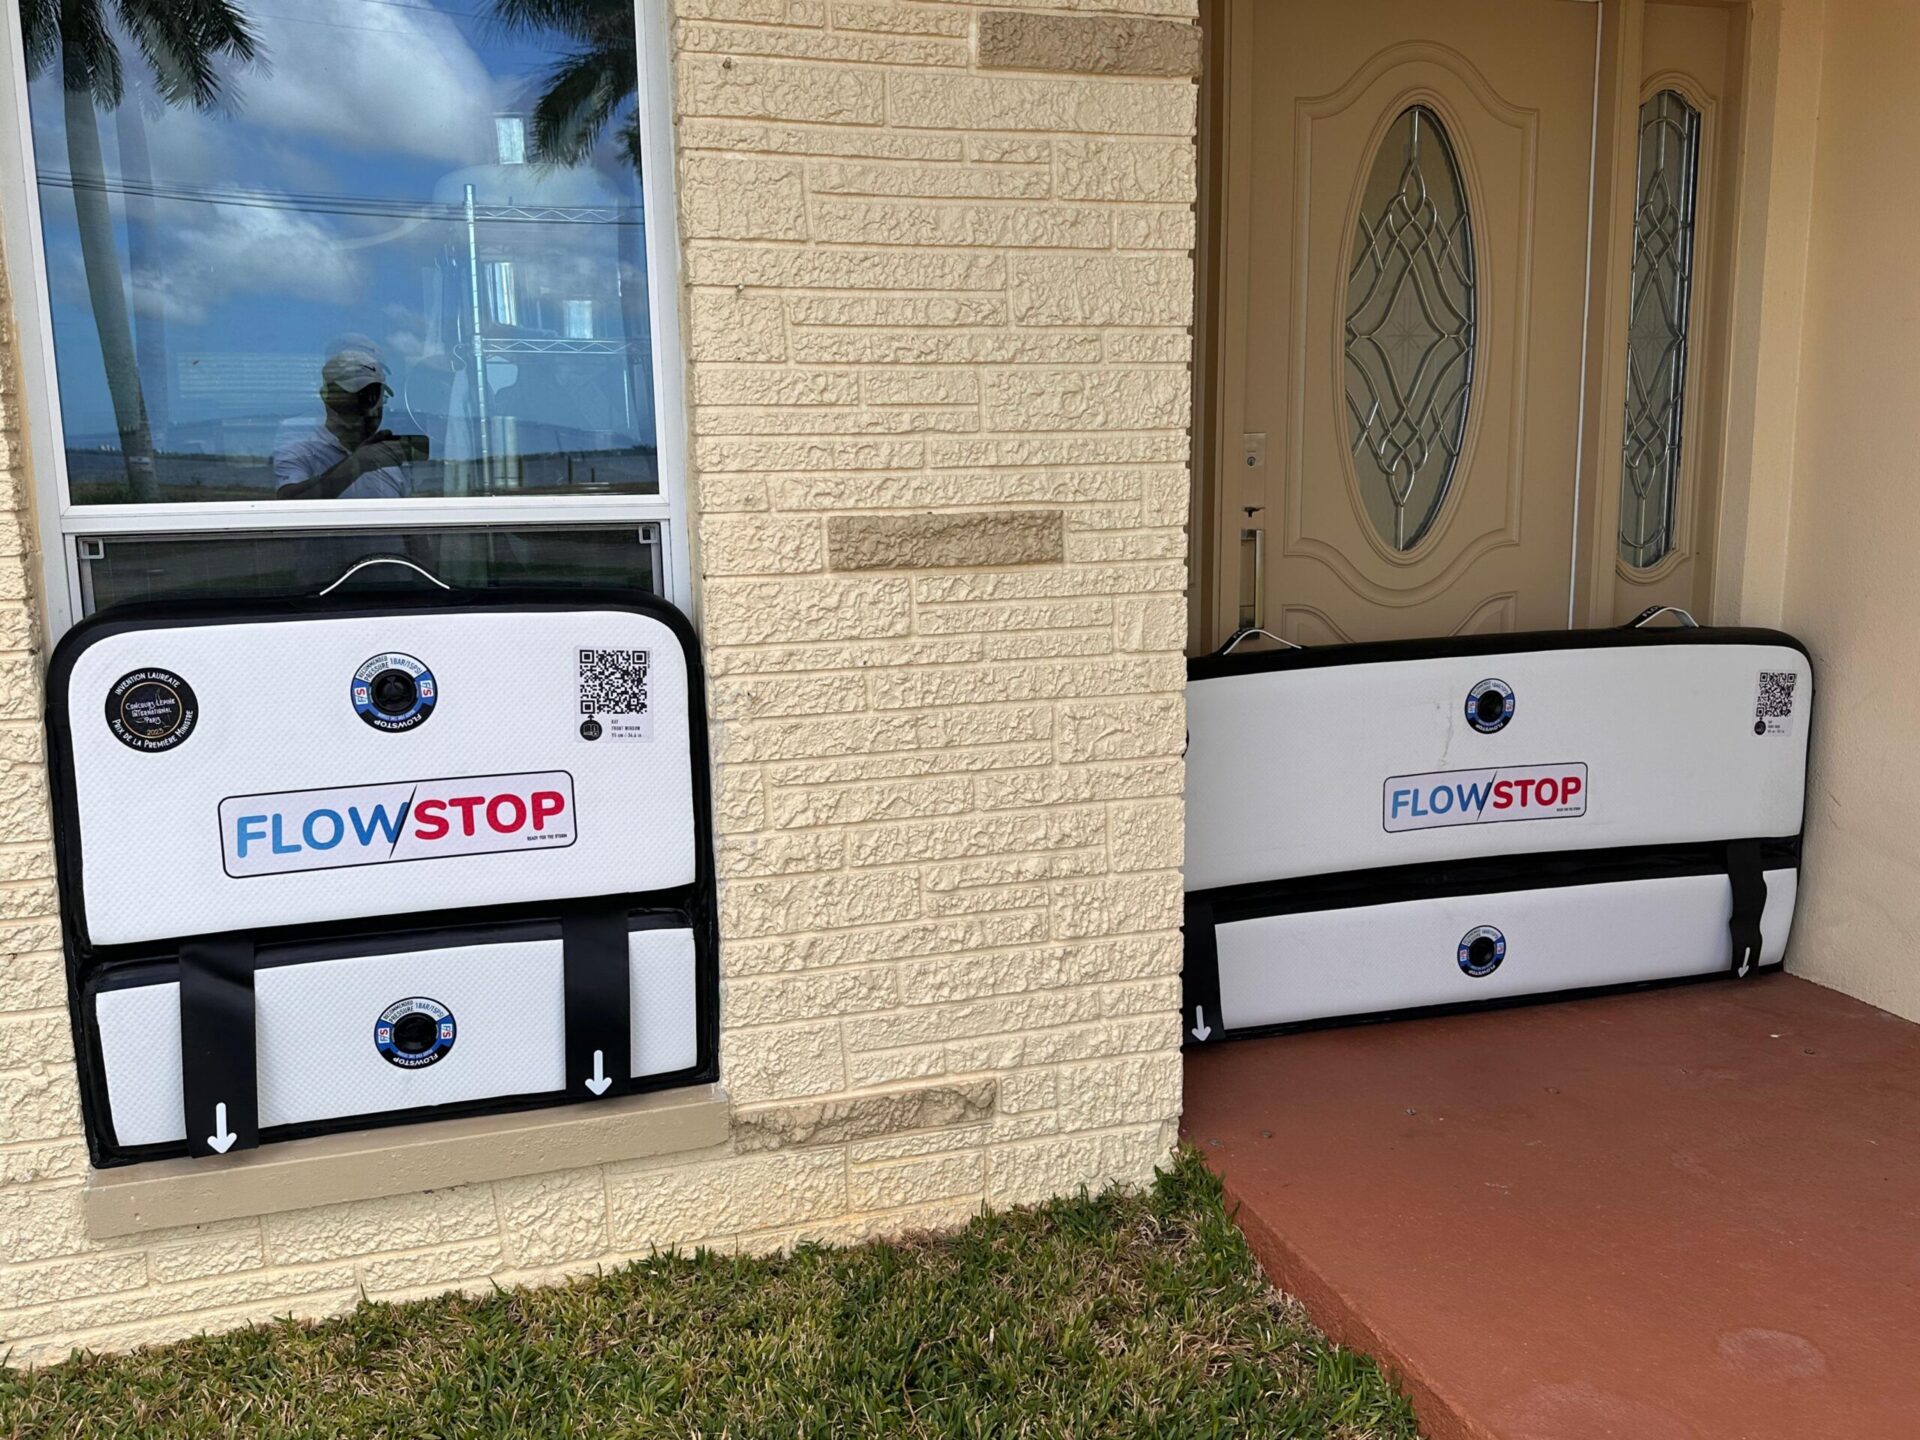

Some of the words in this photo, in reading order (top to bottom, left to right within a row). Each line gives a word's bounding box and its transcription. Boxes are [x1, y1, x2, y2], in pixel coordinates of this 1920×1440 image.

[363, 661, 390, 681] PRESSURE
[115, 673, 145, 695] INVENTION
[112, 718, 125, 735] PRIX
[122, 733, 133, 742] DE
[132, 738, 142, 747] LA
[175, 709, 194, 737] MINISTRE
[383, 1000, 414, 1020] RECOMMENDED
[388, 1006, 414, 1023] PRESSURE
